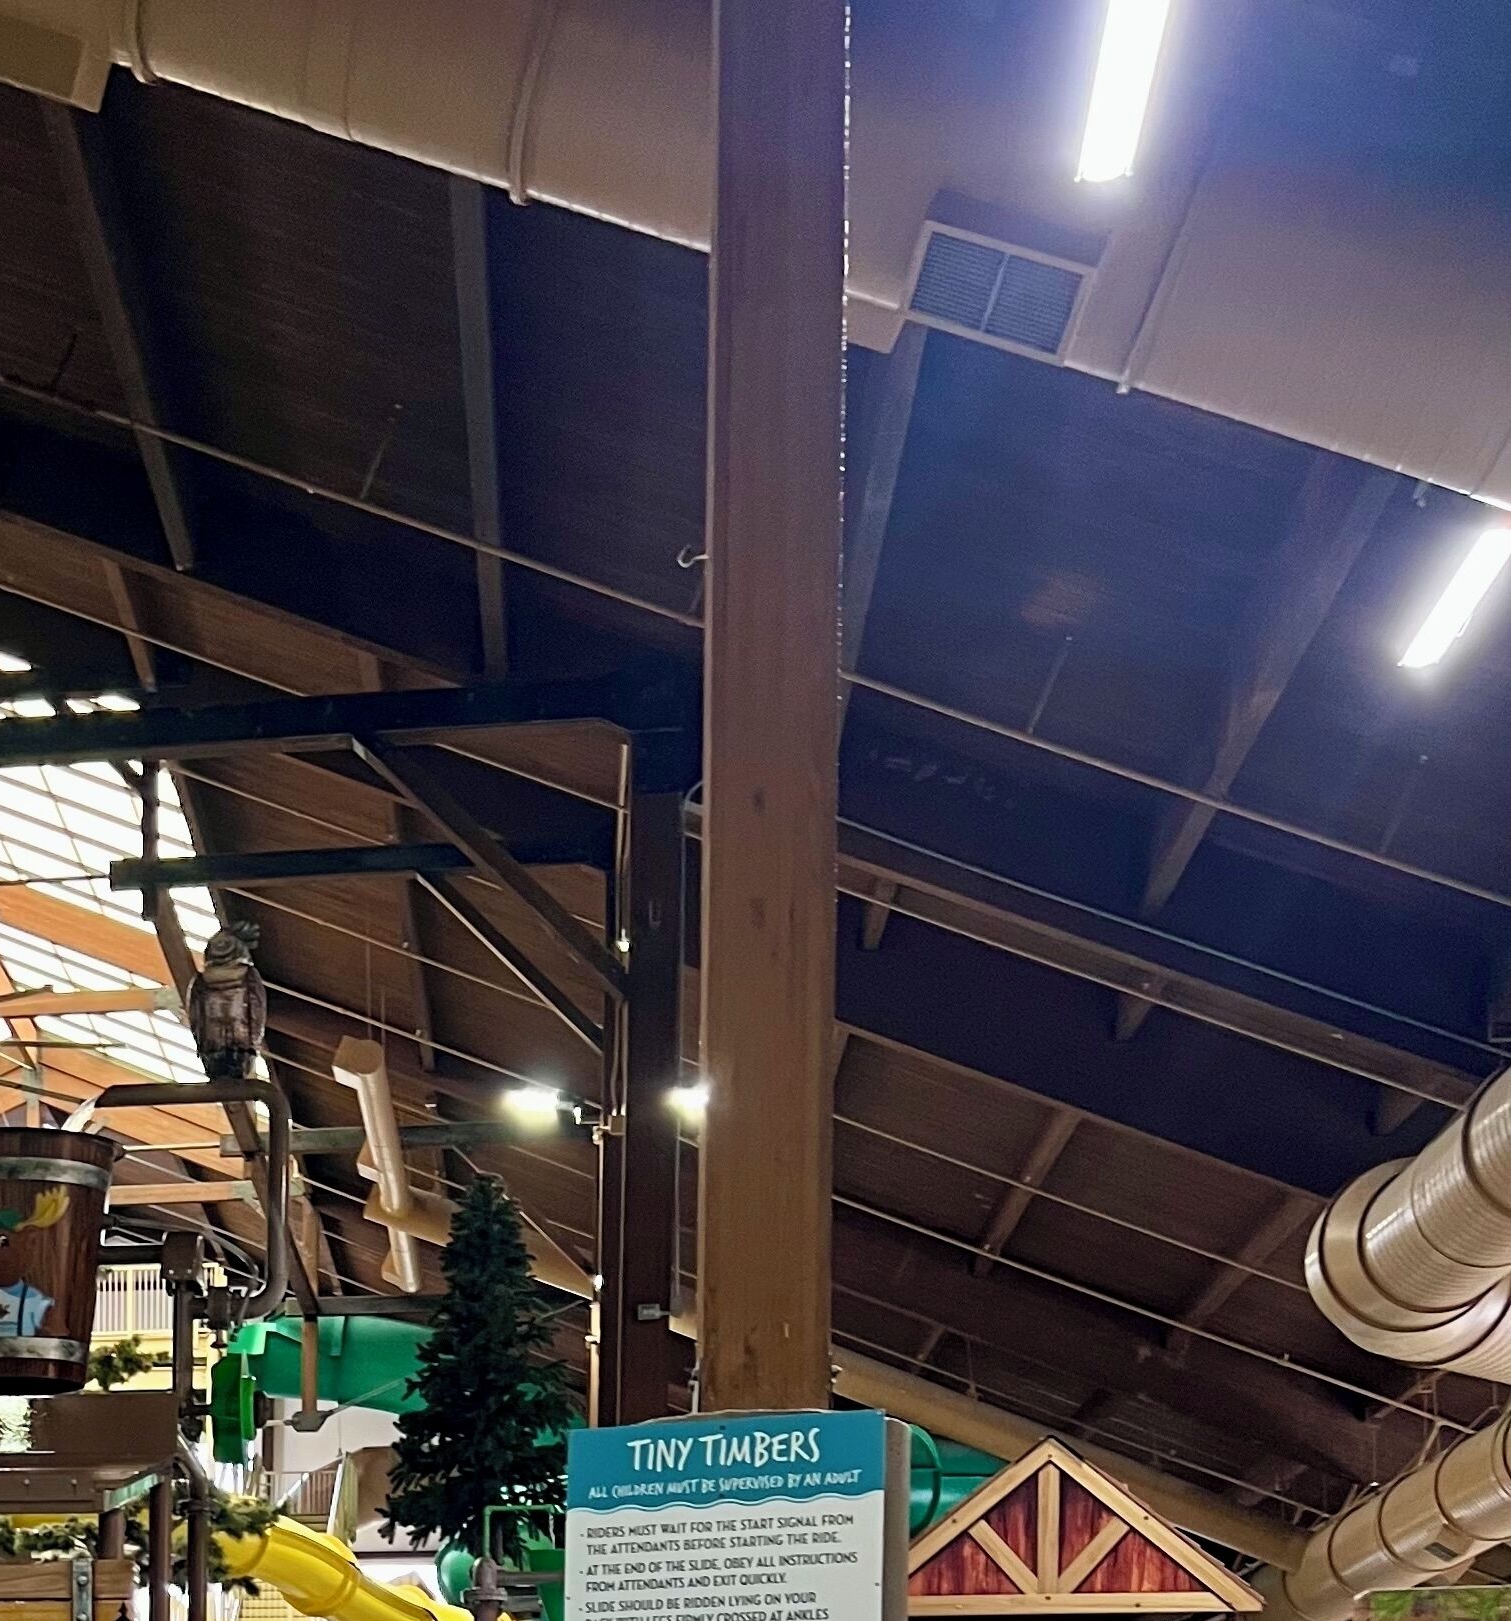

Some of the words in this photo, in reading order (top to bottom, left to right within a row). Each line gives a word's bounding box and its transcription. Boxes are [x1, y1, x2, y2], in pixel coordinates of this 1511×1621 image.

[627, 1438, 693, 1472] TINY
[698, 1427, 820, 1468] TIMBERS
[588, 1485, 608, 1498] ALL
[611, 1482, 663, 1497] CHILDREN
[666, 1479, 699, 1494] MUST
[700, 1478, 715, 1492] BE
[718, 1474, 784, 1491] SUPERVISED
[787, 1473, 802, 1486] BY
[802, 1472, 821, 1486] AN
[823, 1469, 862, 1484] ADULT
[586, 1525, 625, 1538] RIDERS
[628, 1523, 657, 1536] MUST
[659, 1522, 687, 1534] WAIT
[689, 1520, 712, 1533] FOR
[715, 1519, 737, 1531] THE
[740, 1517, 774, 1530] START
[776, 1514, 817, 1528] SIGNAL
[821, 1512, 853, 1525] FROM
[586, 1543, 607, 1556] THE
[609, 1539, 680, 1554] ATTENDANTS
[683, 1537, 726, 1551] BEFORE
[729, 1534, 783, 1548] STARTING
[786, 1532, 808, 1545] THE
[600, 1562, 621, 1575] THE
[623, 1561, 648, 1574] END
[647, 1560, 662, 1573] OF
[664, 1559, 685, 1572] THE
[723, 1556, 753, 1569] OBEY
[756, 1555, 776, 1567] ALL
[778, 1550, 857, 1566] INSTRUCTIONS
[585, 1580, 615, 1592] FROM
[617, 1576, 685, 1591] ATTENDANTS
[686, 1575, 711, 1588] AND
[712, 1574, 736, 1586] EXIT
[585, 1600, 615, 1613] SLIDE
[618, 1598, 664, 1611] SHOULD
[665, 1597, 681, 1609] BE
[682, 1595, 725, 1608] RIDDEN
[728, 1593, 762, 1606] LYING
[763, 1593, 781, 1605] ON
[784, 1591, 816, 1604] YOUR
[785, 1607, 829, 1621] ANKLES
